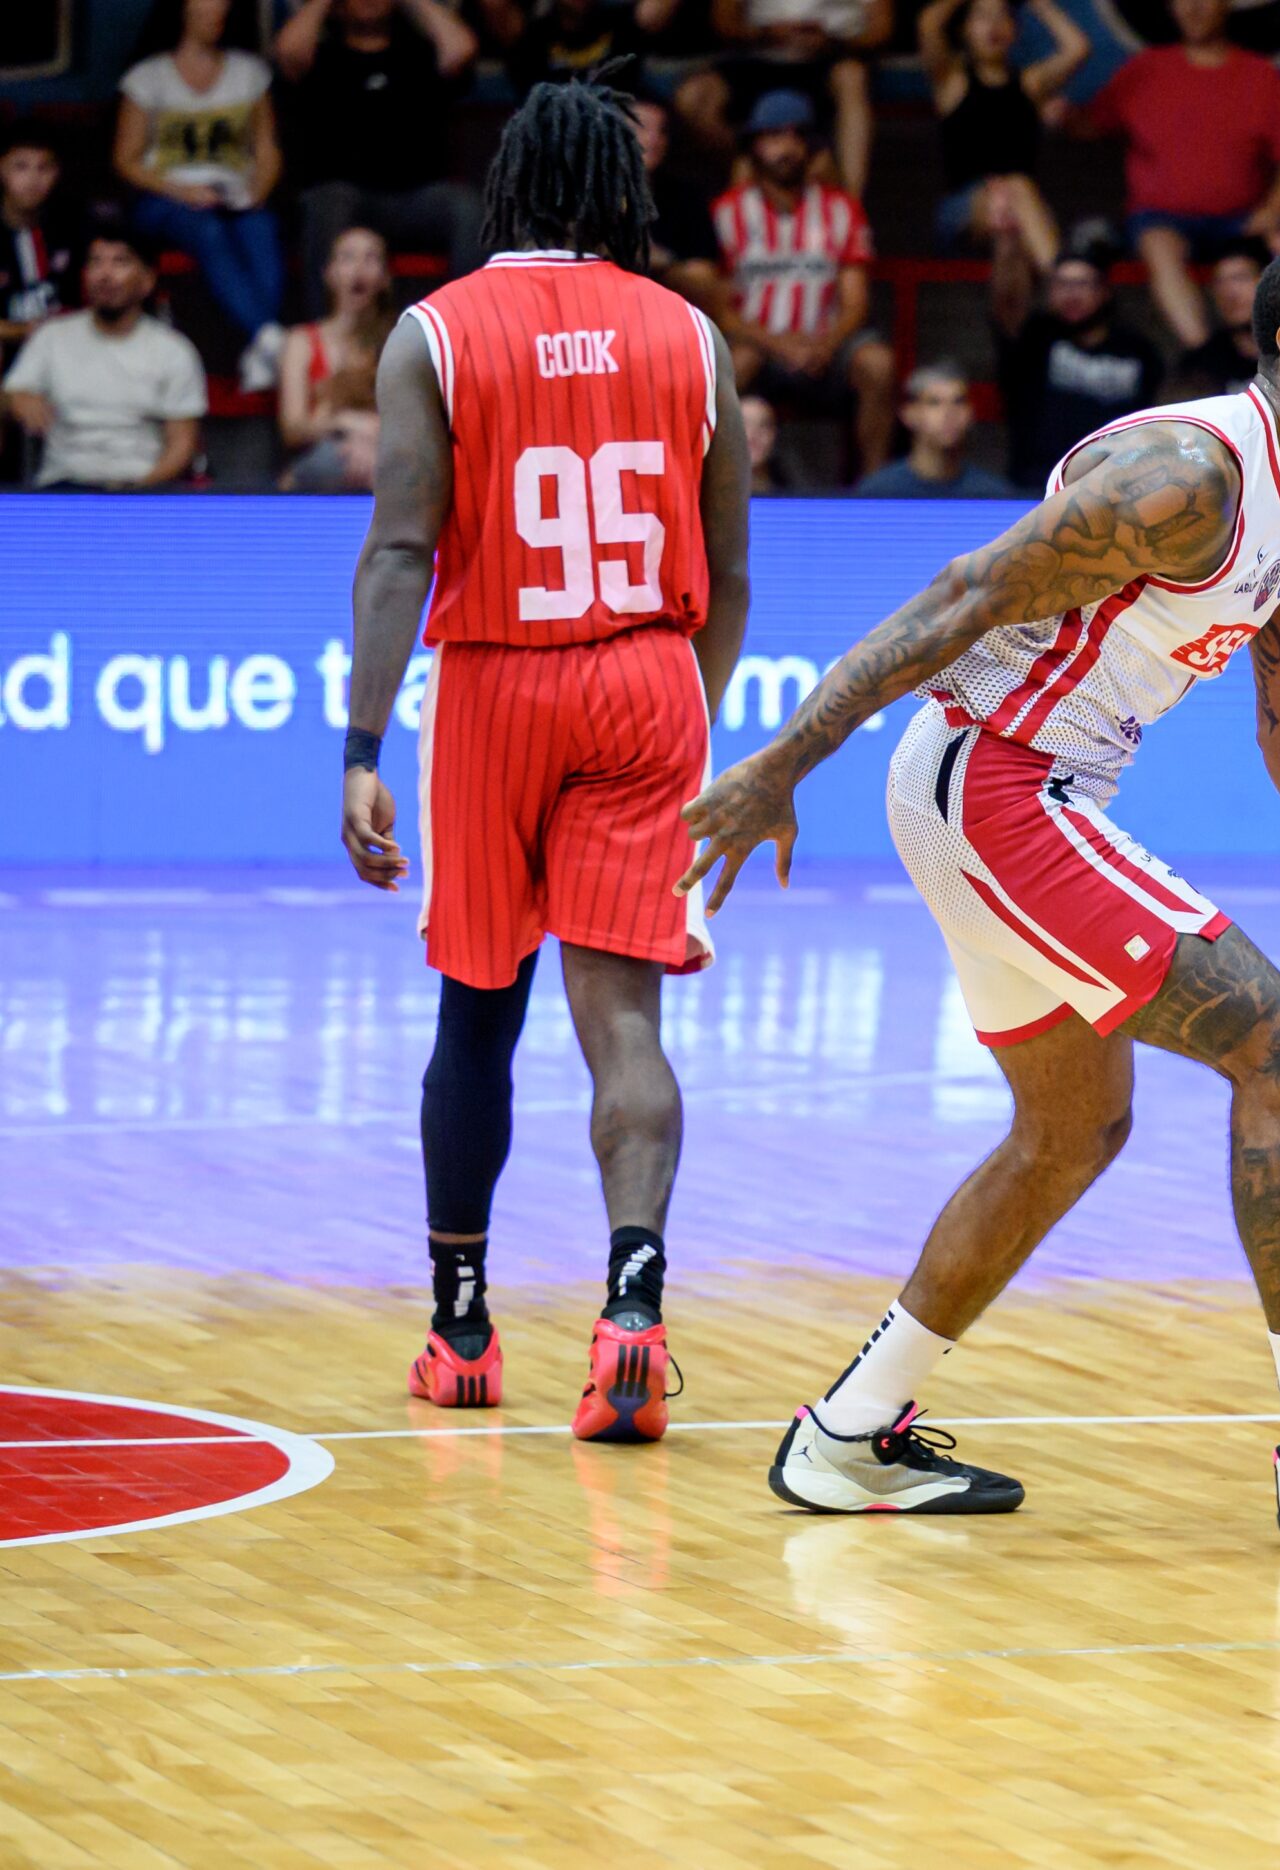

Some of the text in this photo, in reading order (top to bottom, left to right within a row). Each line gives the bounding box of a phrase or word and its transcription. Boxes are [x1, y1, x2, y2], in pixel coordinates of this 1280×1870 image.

[535, 329, 620, 379] COOK
[513, 441, 666, 621] 95
[96, 653, 297, 755] que
